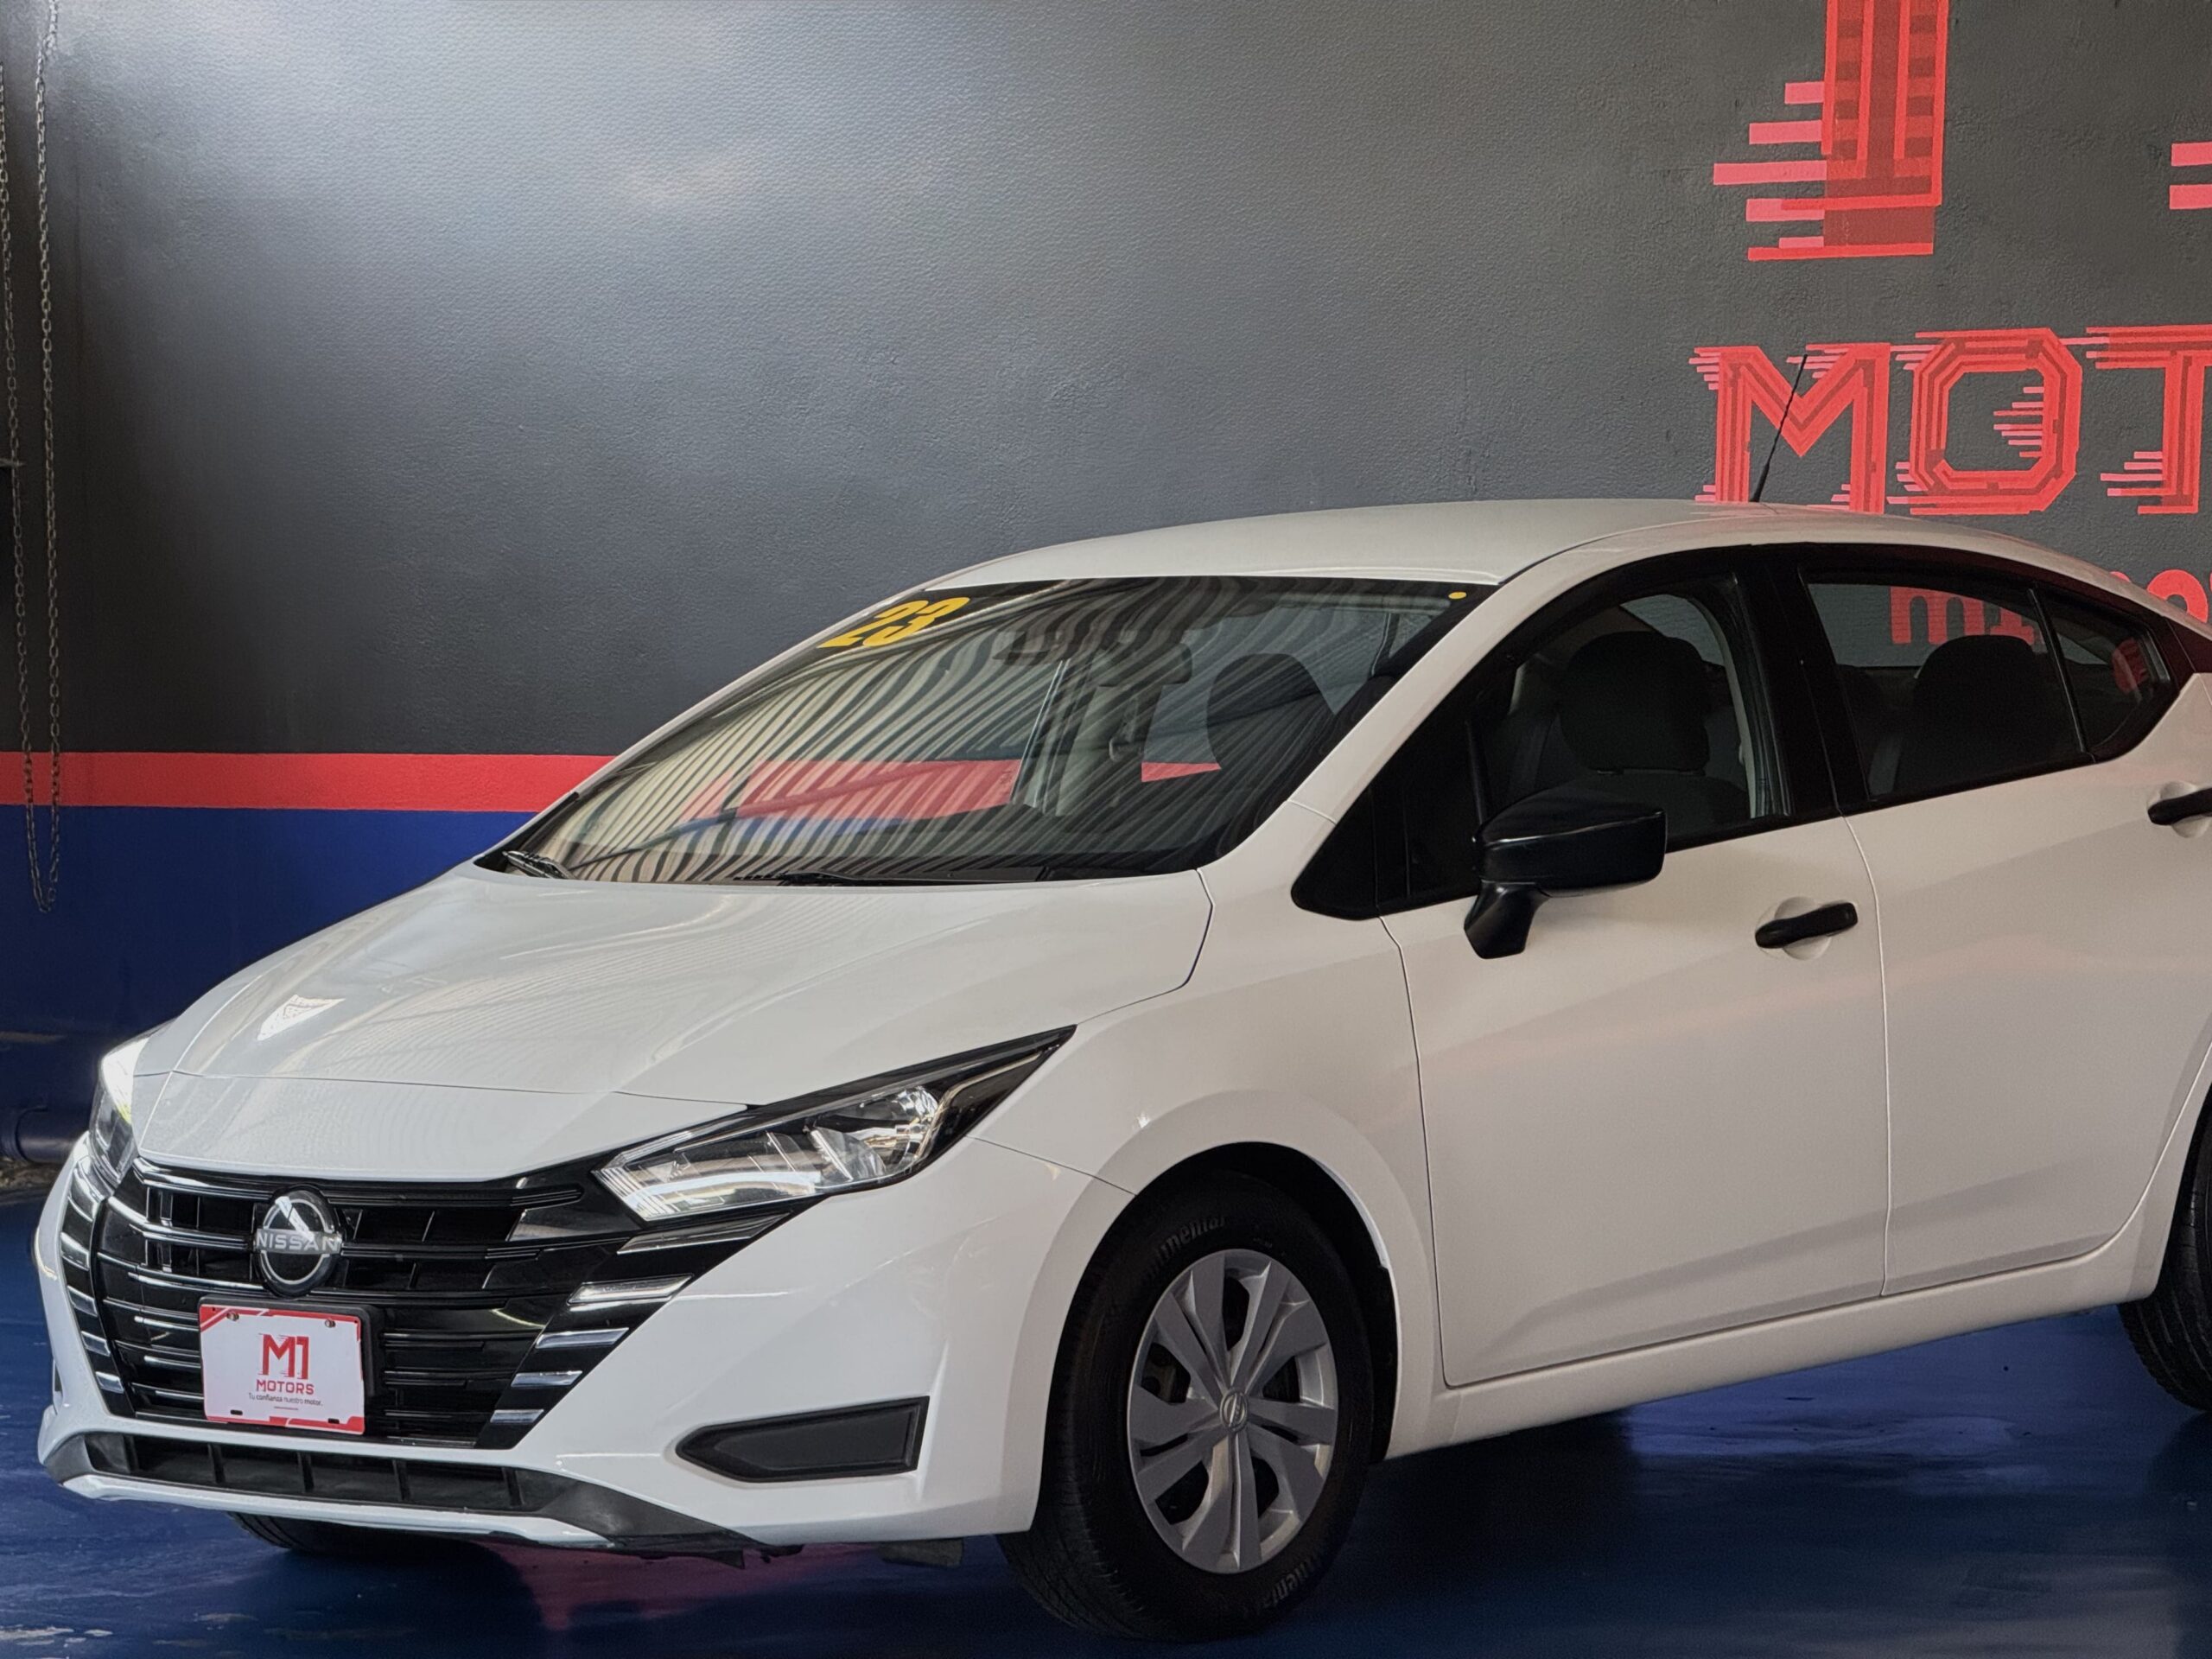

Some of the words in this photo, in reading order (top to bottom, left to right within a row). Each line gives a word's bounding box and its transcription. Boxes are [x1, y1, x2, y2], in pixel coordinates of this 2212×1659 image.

[817, 597, 970, 648] 23
[256, 1231, 341, 1253] NISSAN
[258, 1333, 309, 1380] M1
[256, 1379, 315, 1395] MOTORS
[257, 1394, 283, 1402] confianza
